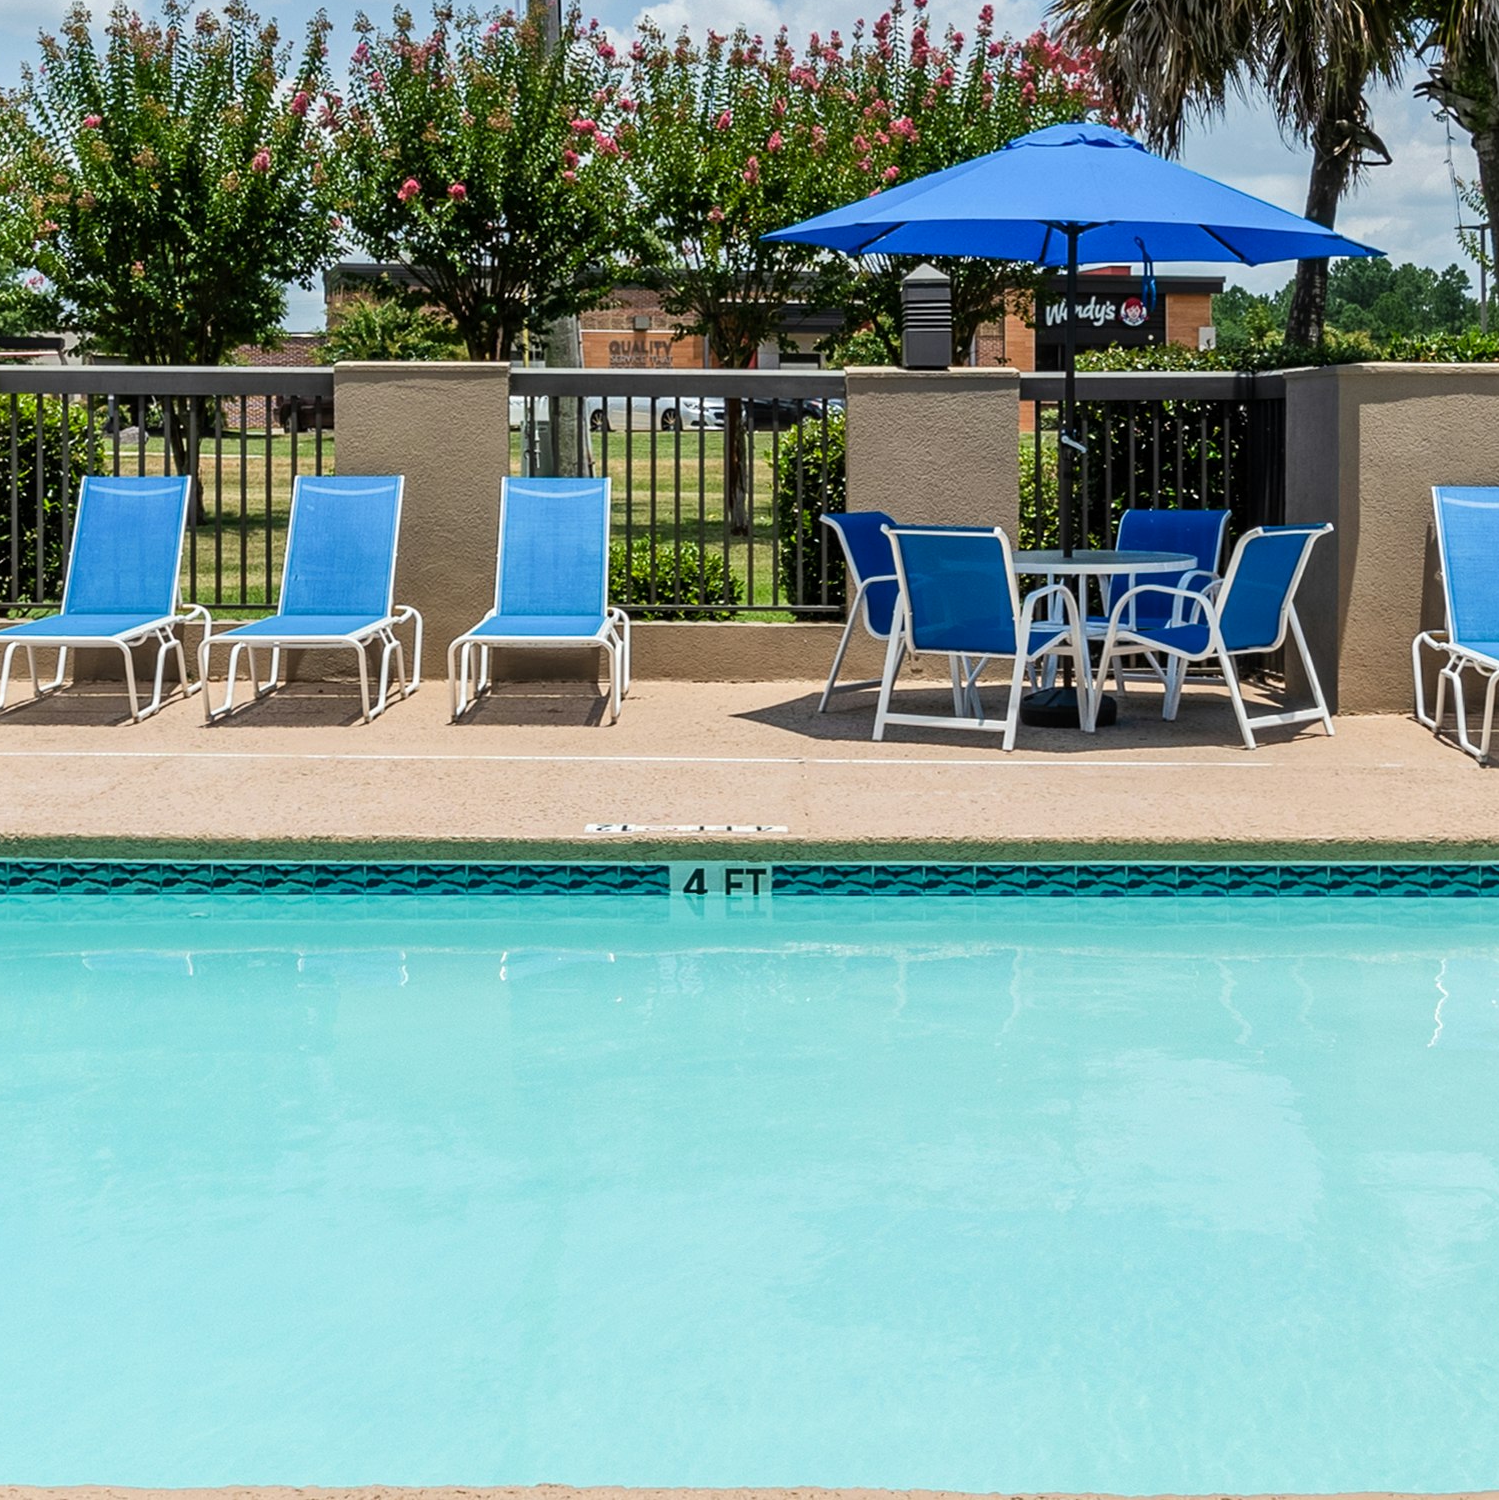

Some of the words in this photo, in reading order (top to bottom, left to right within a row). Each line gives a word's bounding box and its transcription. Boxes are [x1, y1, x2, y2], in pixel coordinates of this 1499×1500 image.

[1045, 296, 1116, 327] Wndy's
[608, 340, 673, 355] QUALITY
[683, 868, 708, 895] 4
[725, 868, 767, 895] FT
